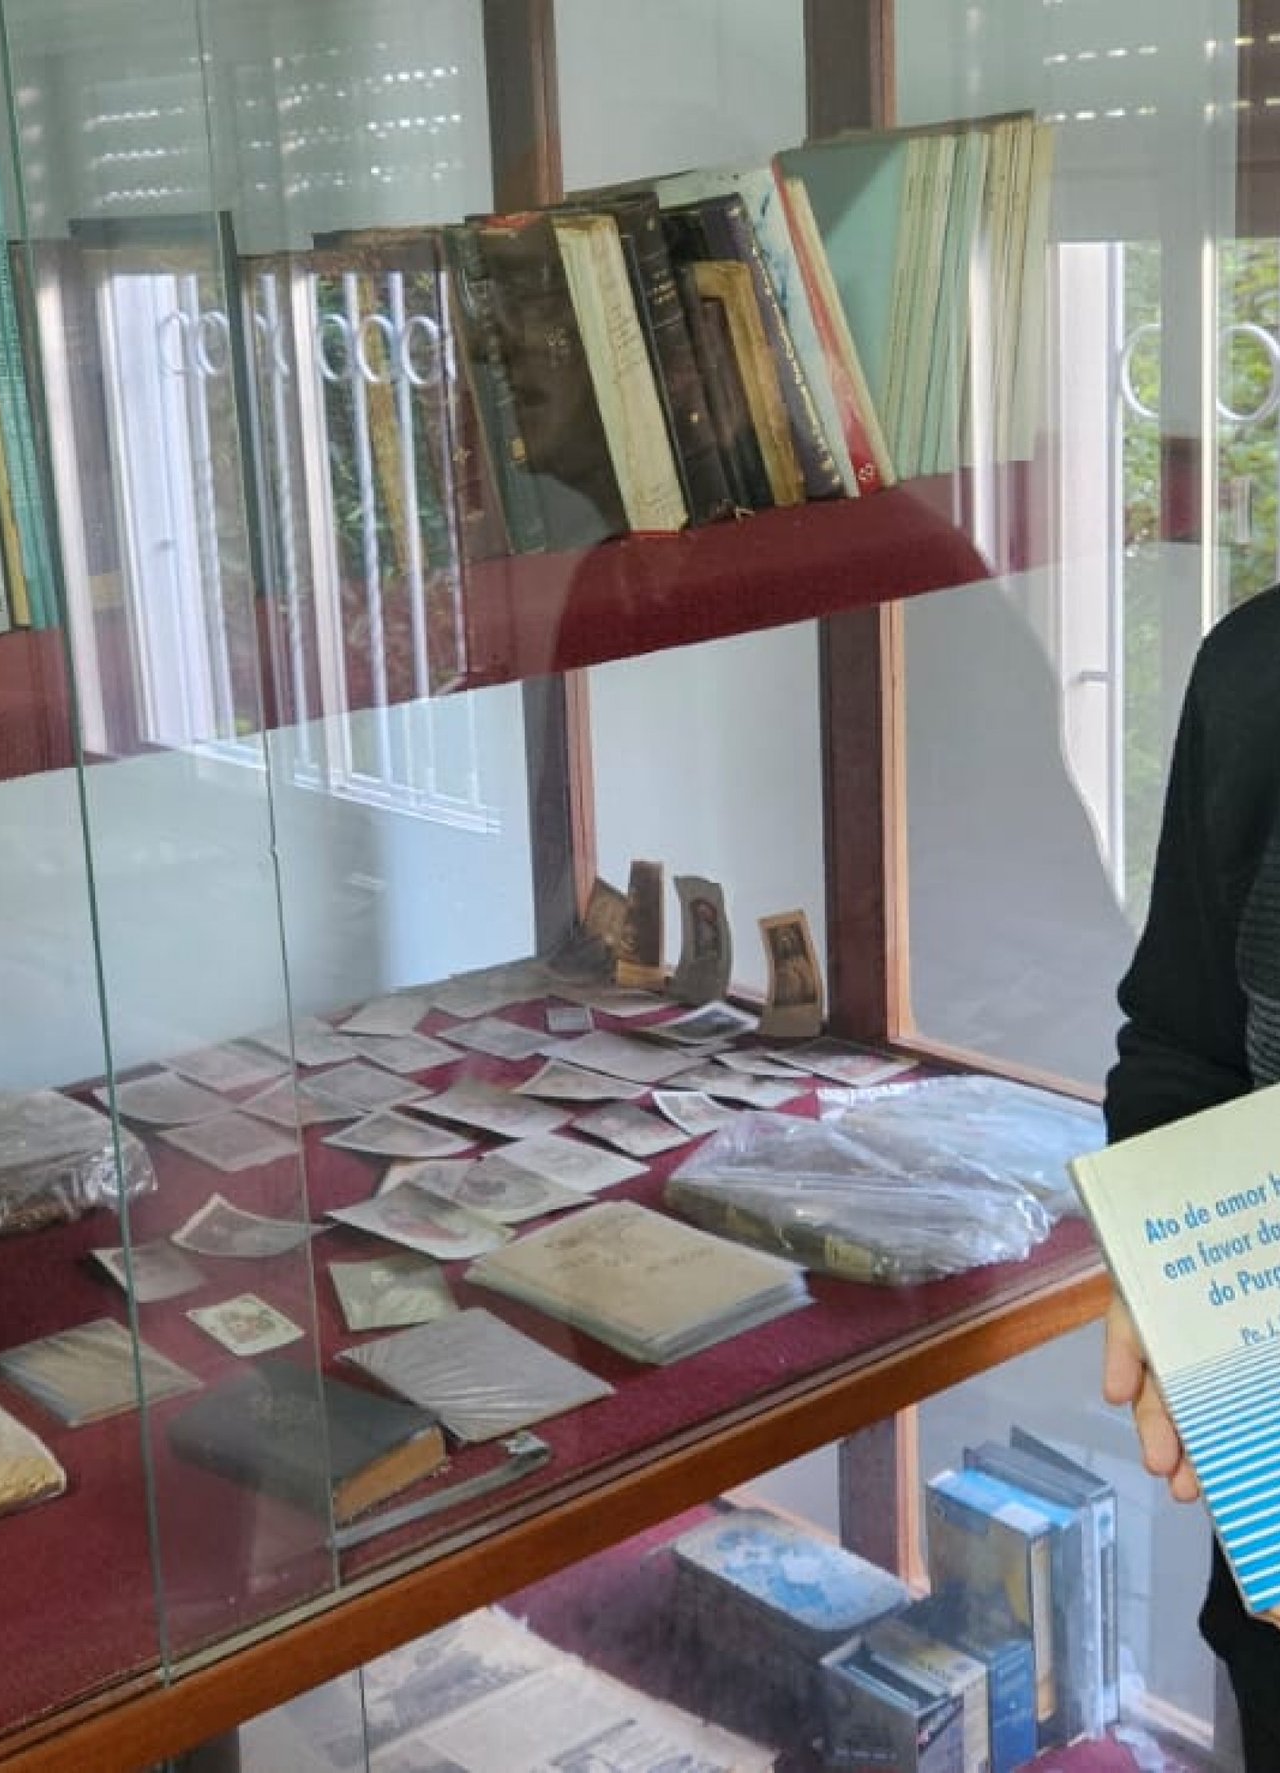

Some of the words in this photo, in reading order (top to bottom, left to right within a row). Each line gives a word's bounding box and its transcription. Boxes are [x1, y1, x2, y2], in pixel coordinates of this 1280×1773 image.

[1144, 1217, 1181, 1244] Ato
[1184, 1201, 1211, 1229] de
[1215, 1185, 1268, 1218] amor
[1163, 1254, 1197, 1280] em
[1196, 1232, 1253, 1267] favor
[1209, 1278, 1236, 1306] do
